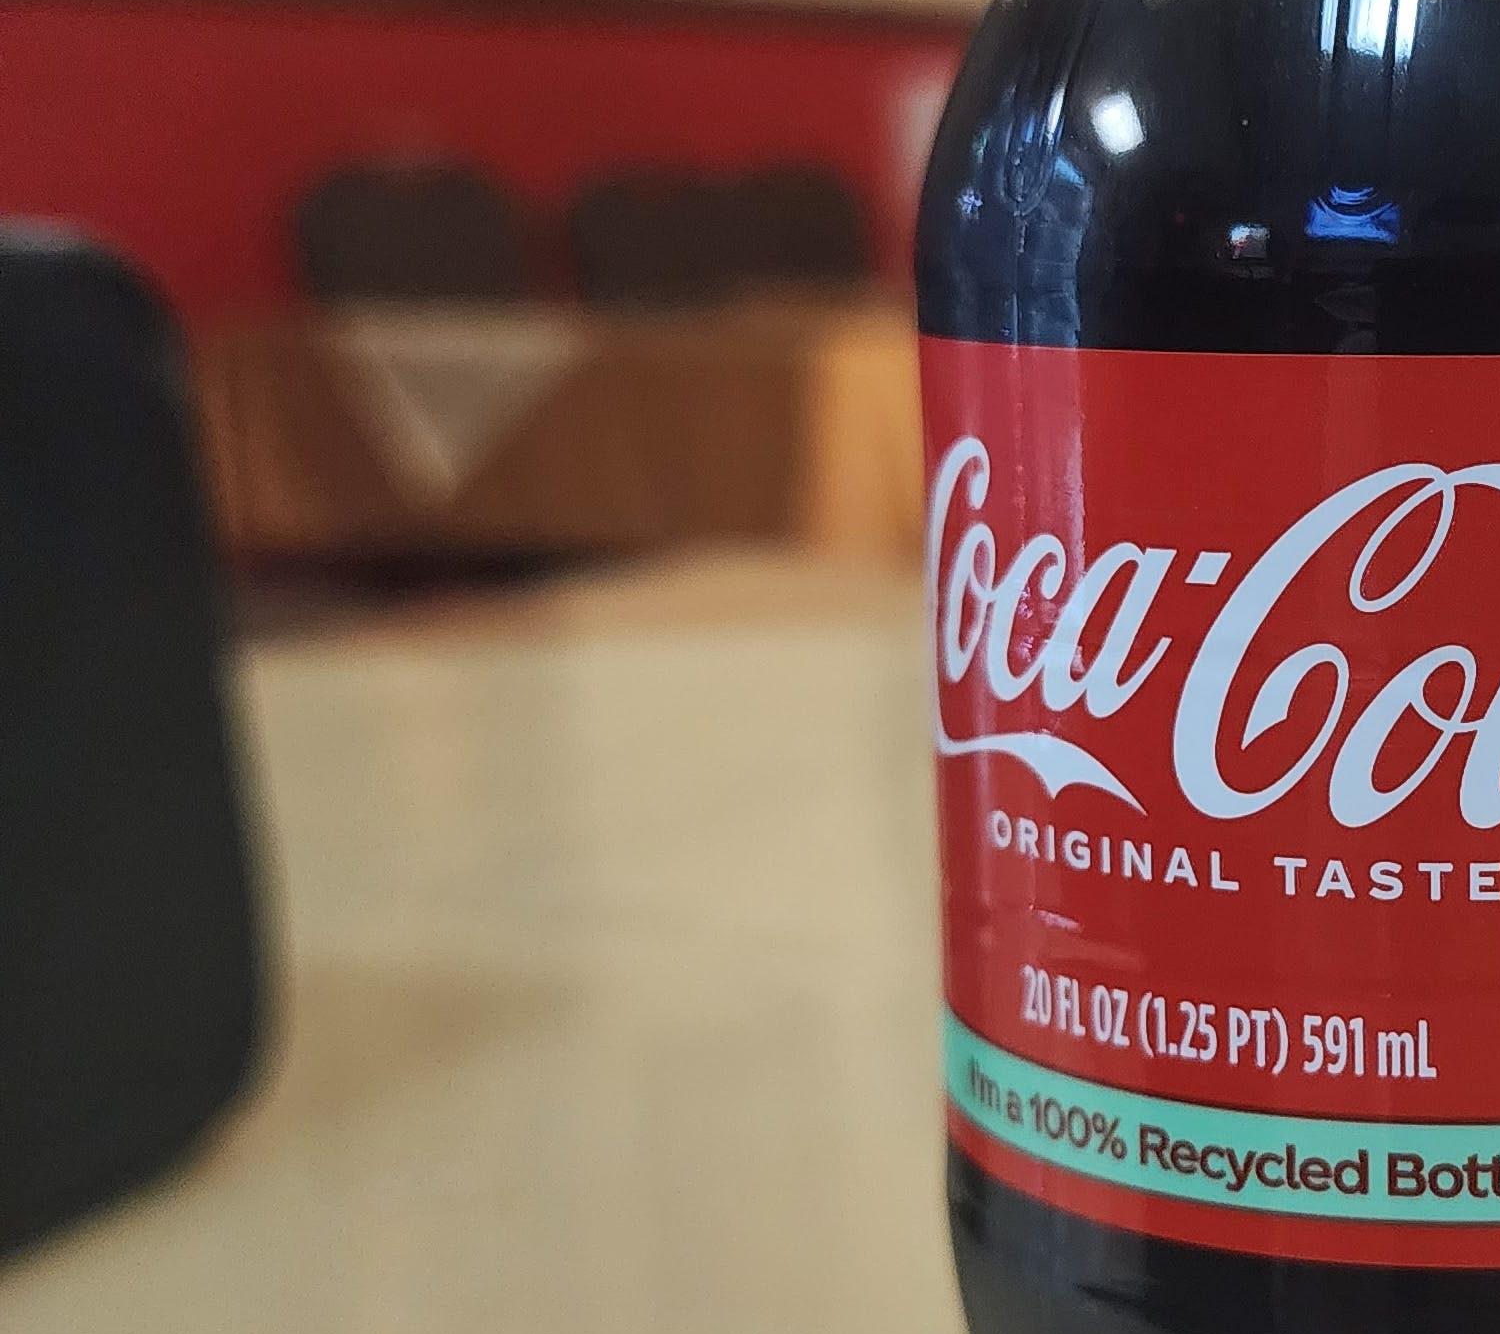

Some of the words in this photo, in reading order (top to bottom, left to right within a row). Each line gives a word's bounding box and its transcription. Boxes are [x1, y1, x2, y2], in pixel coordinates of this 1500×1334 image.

[988, 809, 1240, 892] ORIGINAL
[1019, 963, 1053, 1027] 20
[1055, 973, 1087, 1038] FL
[1091, 984, 1131, 1047] OZ
[1138, 990, 1219, 1063] (1.25
[1228, 1005, 1289, 1077] PT)
[1302, 1014, 1366, 1078] 591
[1376, 1018, 1438, 1079] mL
[1006, 1088, 1024, 1126] a
[1029, 1090, 1128, 1161] 100%
[1138, 1122, 1369, 1197] Recycled
